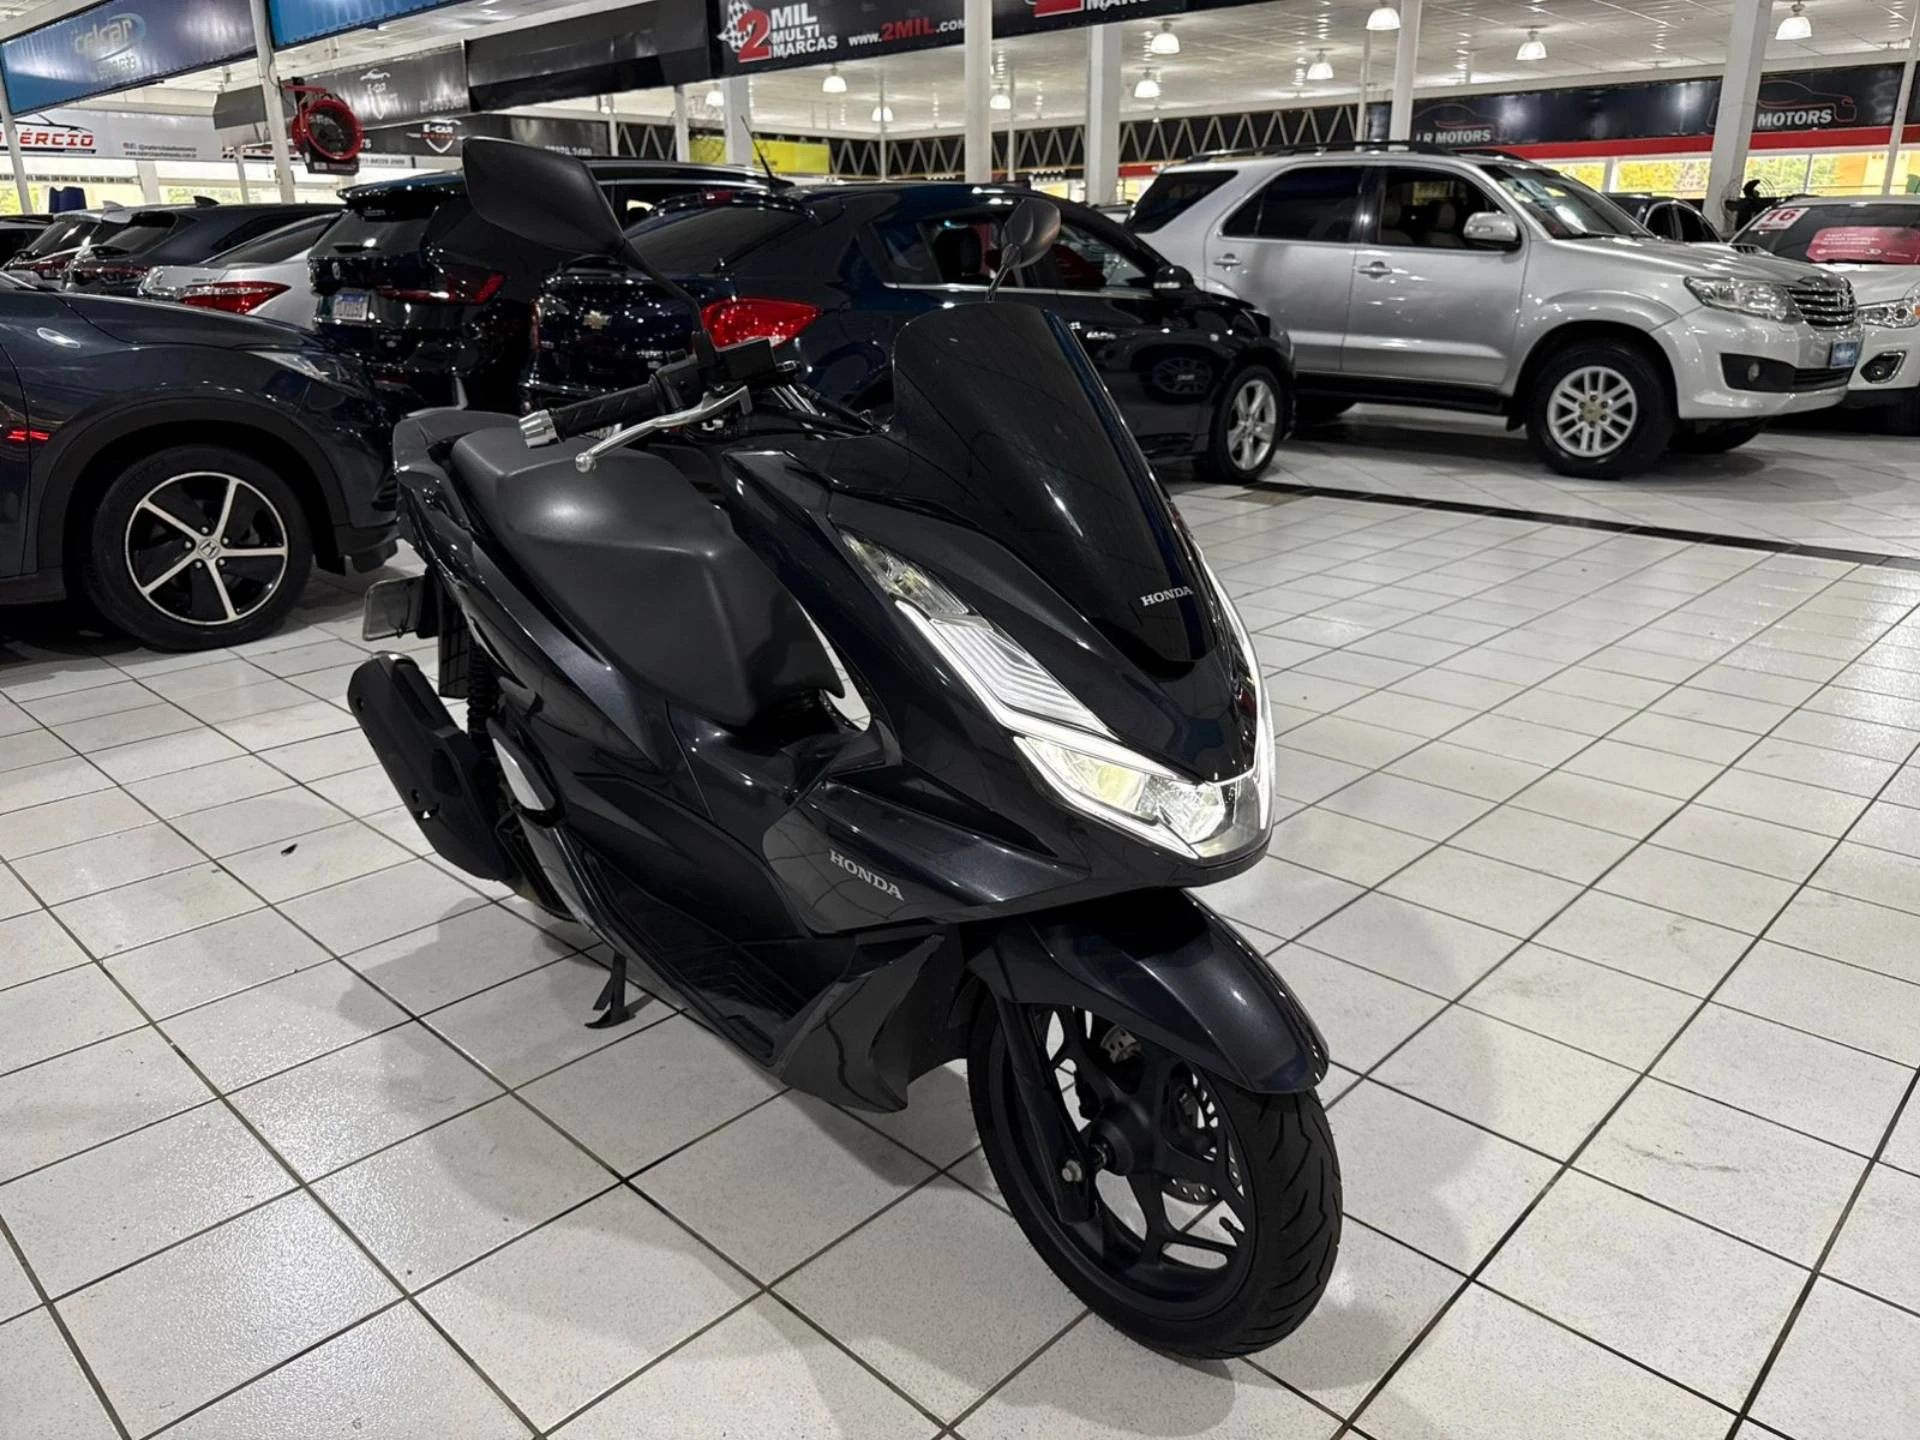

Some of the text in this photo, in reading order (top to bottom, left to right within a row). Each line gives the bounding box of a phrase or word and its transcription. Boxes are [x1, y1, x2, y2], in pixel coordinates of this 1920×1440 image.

[738, 3, 817, 63] 2 MIL
[771, 25, 819, 44] MULTI
[772, 36, 838, 58] MARCAS
[1757, 109, 1832, 127] MOTORS
[20, 128, 94, 147] ÉRCIO
[1435, 129, 1491, 144] MOTORS
[1140, 586, 1194, 606] HONDA
[829, 848, 905, 902] HONDA
